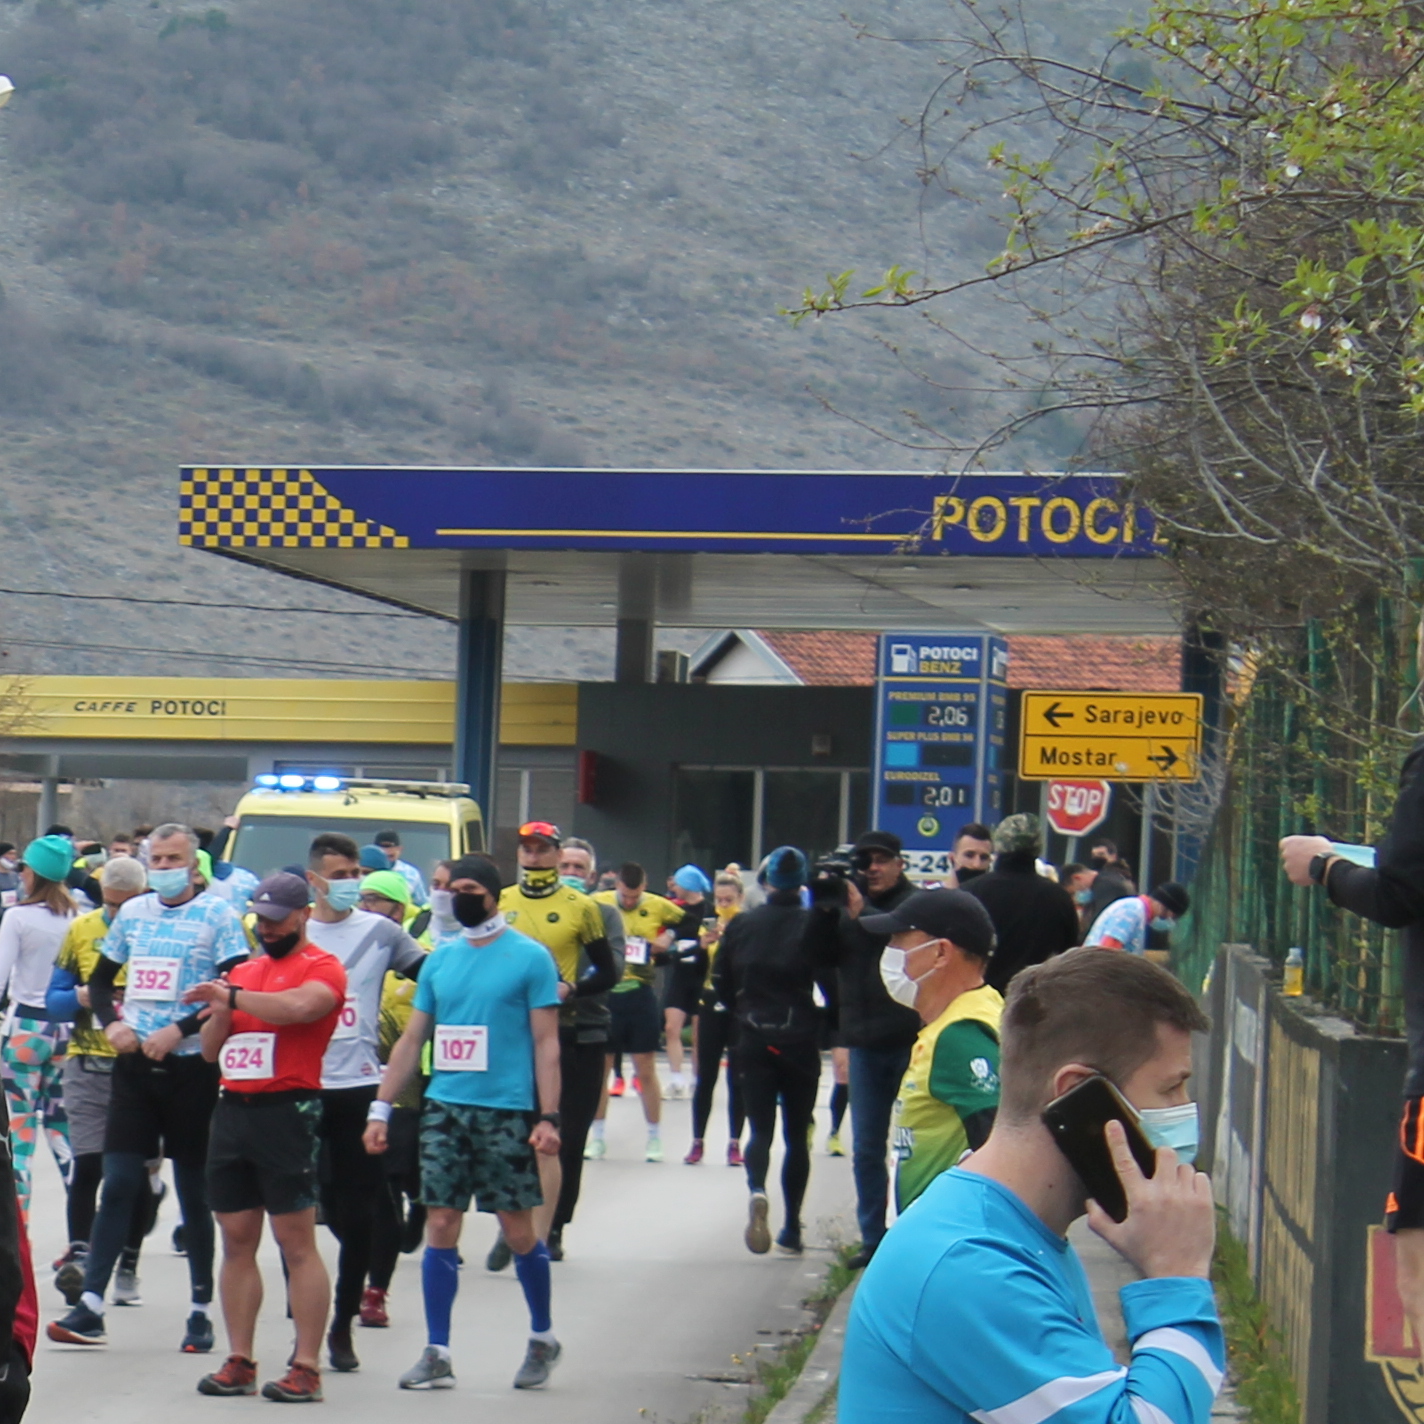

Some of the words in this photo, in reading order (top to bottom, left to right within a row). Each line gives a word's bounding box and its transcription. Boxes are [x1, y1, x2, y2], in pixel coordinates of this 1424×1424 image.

[931, 496, 1135, 544] POTOCI
[918, 646, 978, 661] POTOCI
[918, 661, 962, 674] BENZ
[73, 701, 137, 713] CAFFE
[150, 700, 226, 716] POTOCI
[927, 705, 969, 727] 2,06
[1084, 704, 1184, 729] Sarajevo
[1040, 746, 1117, 766] Mostar
[923, 786, 965, 807] 2,01
[1048, 783, 1101, 815] STOP
[134, 969, 172, 990] 392
[224, 1047, 264, 1069] 624
[441, 1039, 477, 1060] 107
